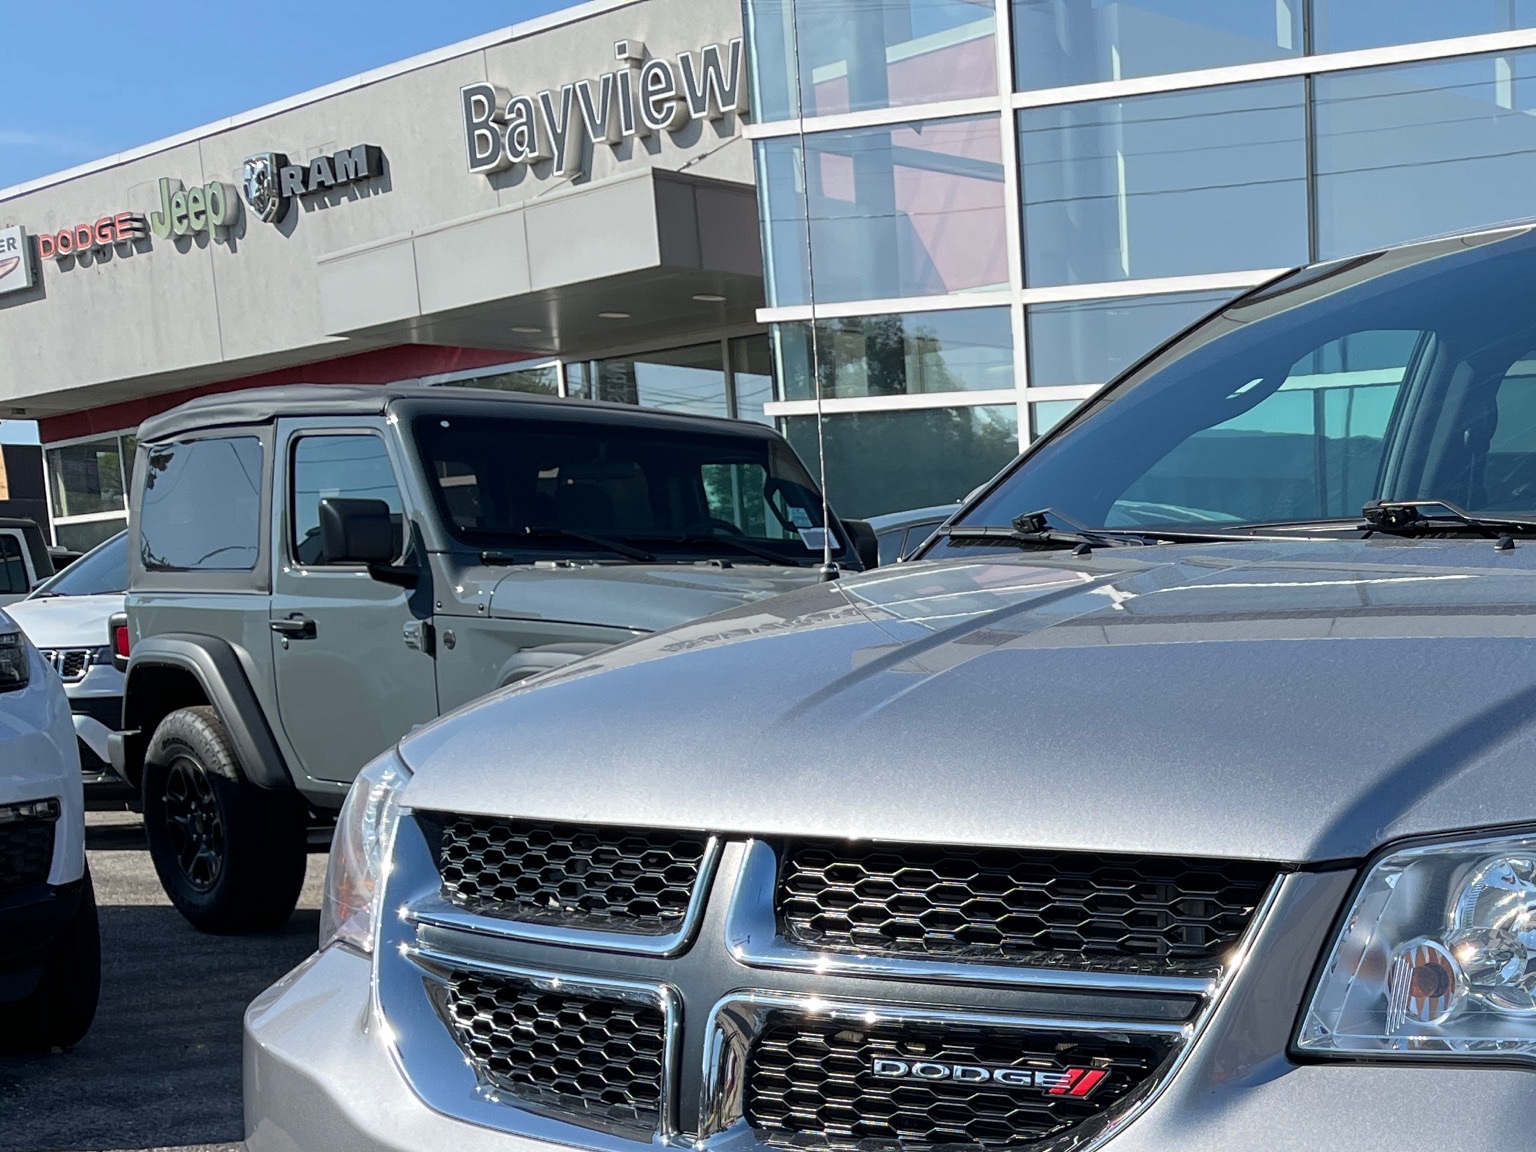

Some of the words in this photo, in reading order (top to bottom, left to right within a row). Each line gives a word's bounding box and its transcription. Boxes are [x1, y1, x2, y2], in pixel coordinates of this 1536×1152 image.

[460, 37, 743, 176] Bayview
[280, 144, 370, 197] RAM
[151, 177, 226, 240] Jeep
[38, 211, 134, 260] DODGE
[873, 1058, 1073, 1090] DODGE
